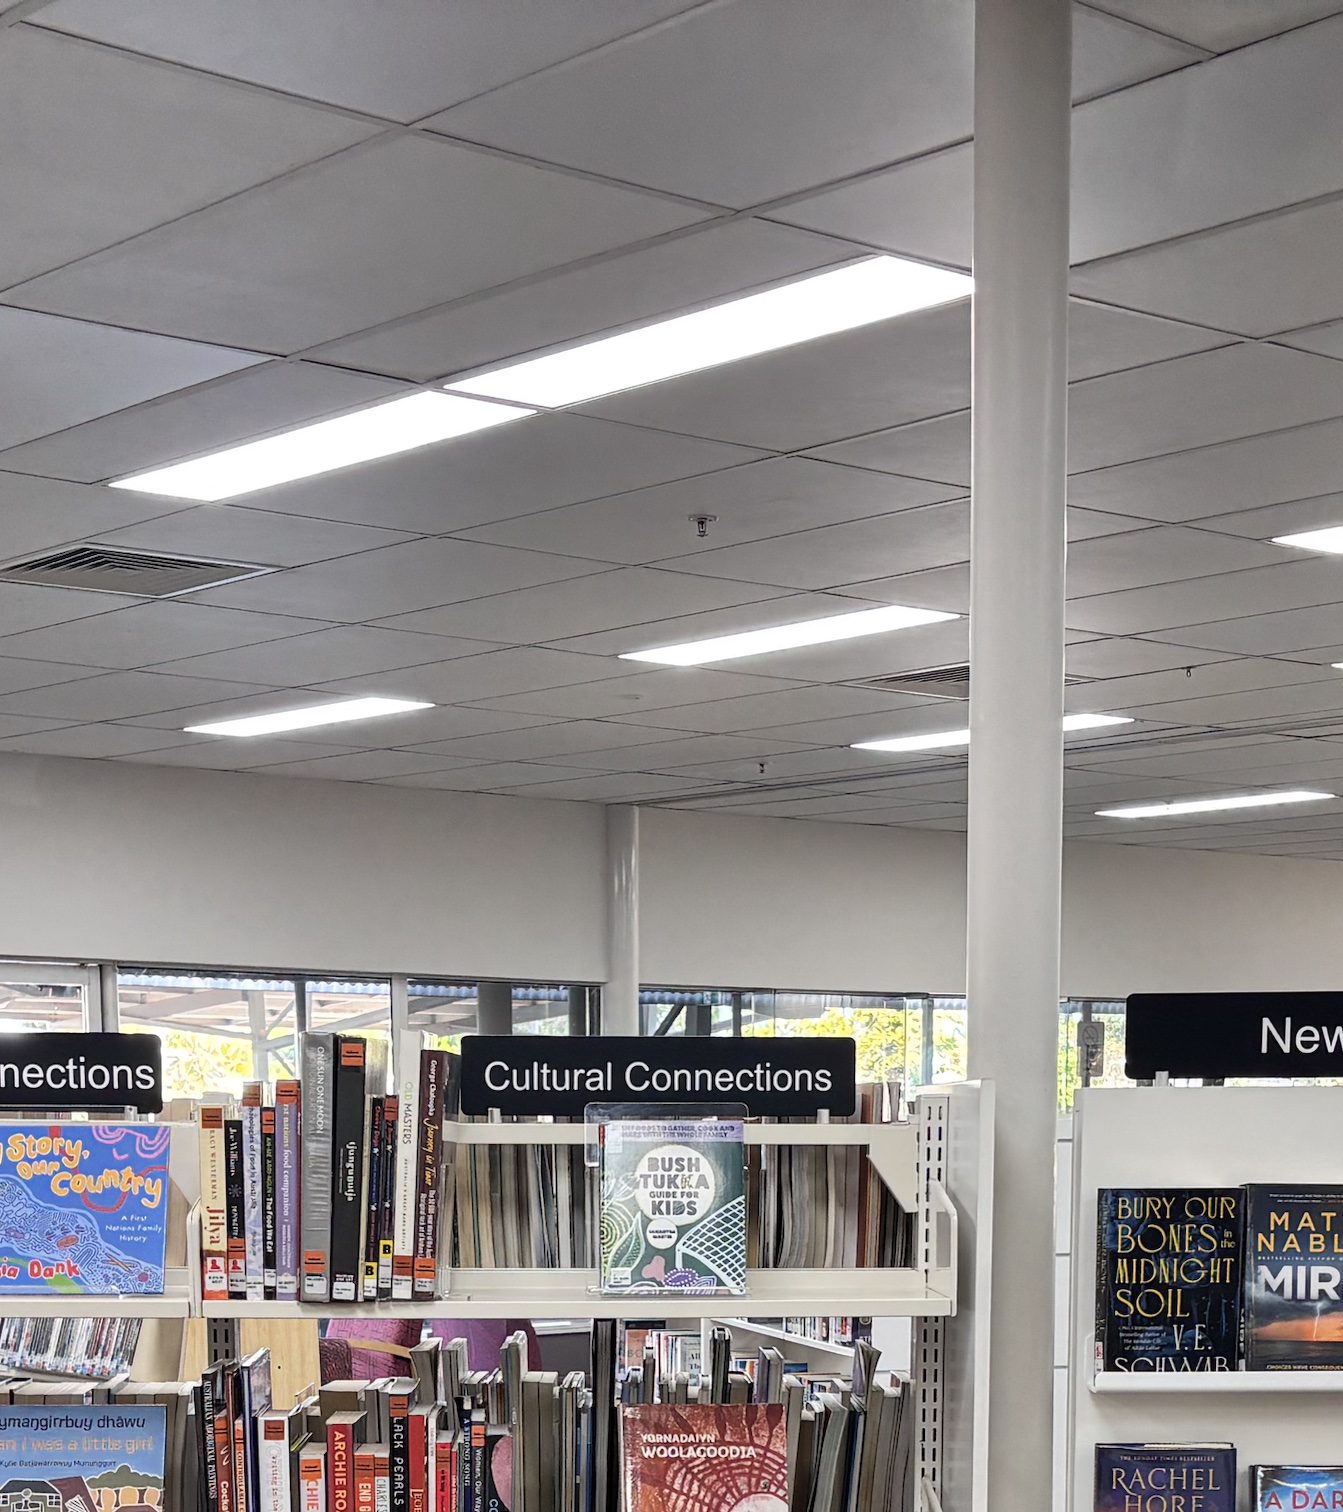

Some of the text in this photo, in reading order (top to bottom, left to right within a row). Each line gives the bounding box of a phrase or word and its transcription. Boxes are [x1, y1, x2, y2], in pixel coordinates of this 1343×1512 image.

[484, 1061, 832, 1092] Cultural Connections
[403, 1103, 412, 1145] MASTERS
[6, 1133, 90, 1168] Story,
[647, 1157, 700, 1172] BUSH
[51, 1170, 163, 1209] Country
[651, 1200, 697, 1215] KIDS
[1117, 1197, 1180, 1220] BURY
[105, 1223, 162, 1233] Nations Family
[119, 1234, 147, 1243] History
[207, 1205, 225, 1245] Jilya
[1117, 1224, 1218, 1253] BONES
[27, 1257, 81, 1279] Dank
[1114, 1258, 1234, 1284] MIDNIGHT
[1114, 1289, 1190, 1318] SOIL
[333, 1430, 347, 1486] ARCHIE
[359, 1482, 371, 1502] END
[393, 1456, 404, 1506] PEARLS
[1112, 1468, 1221, 1496] RACHEL
